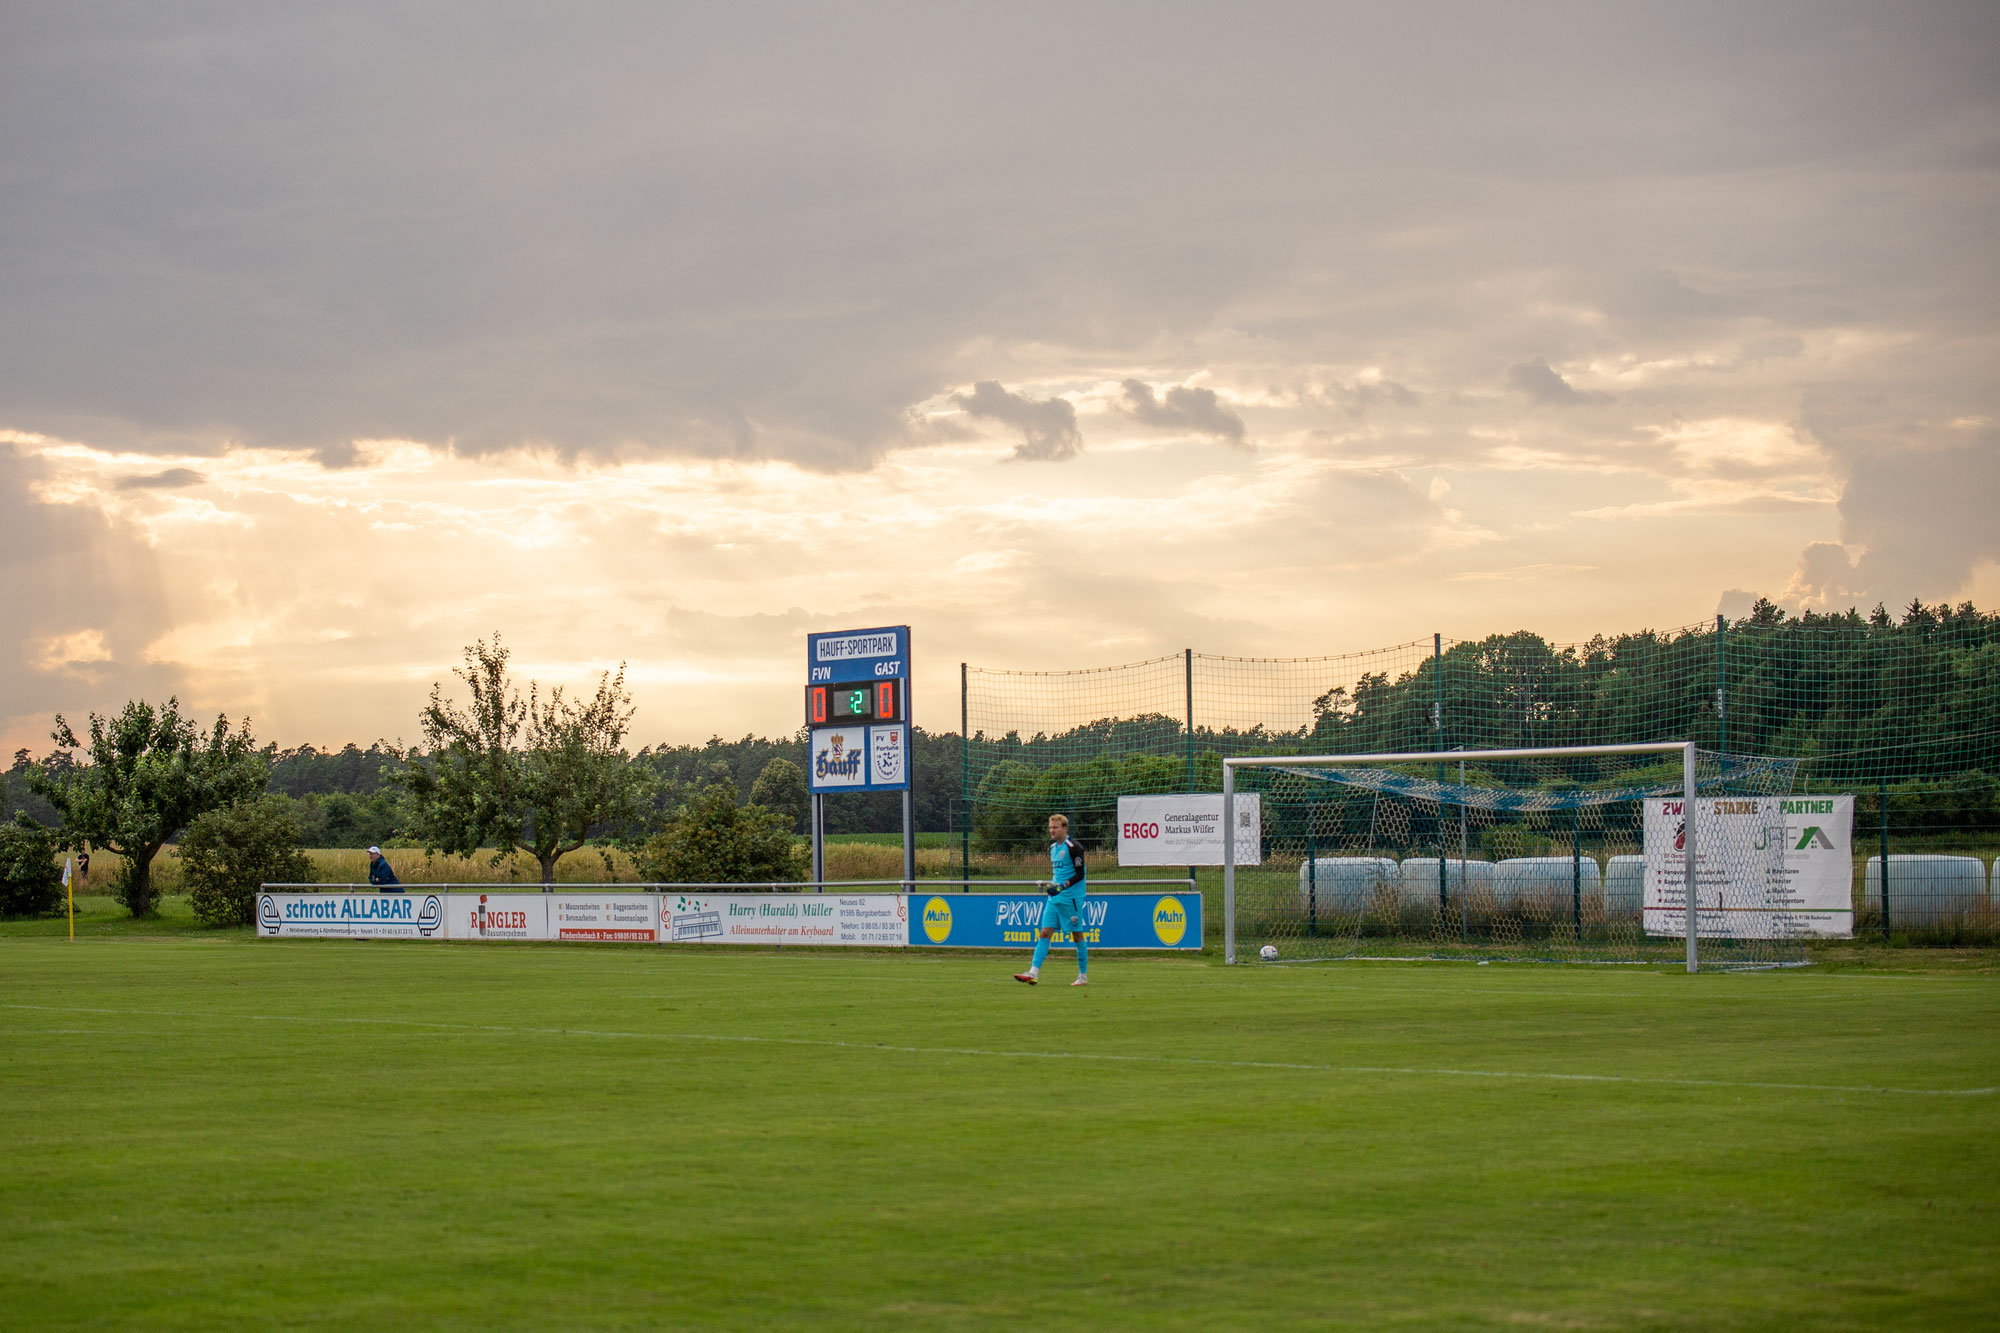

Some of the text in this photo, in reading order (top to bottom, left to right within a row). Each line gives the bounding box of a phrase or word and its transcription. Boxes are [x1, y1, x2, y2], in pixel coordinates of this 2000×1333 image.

[820, 636, 894, 657] HAUFF-SPORTPARK
[812, 661, 901, 680] FVN GAST
[816, 748, 863, 780] Hauff
[1713, 801, 1758, 815] STARKE
[1780, 800, 1833, 814] PARTNER
[1164, 813, 1219, 823] Generalagentur
[1123, 823, 1159, 839] ERGO
[1164, 825, 1215, 834] Markus Wilfer
[286, 899, 412, 919] schrott ALLABAR
[613, 903, 648, 911] Baggerarbeiten
[729, 903, 833, 919] Harry (Harald) Müller
[856, 909, 892, 918] Burgoberbach
[996, 901, 1043, 926] PKW
[925, 909, 949, 921] Muhr
[1156, 909, 1183, 922] Muhr
[729, 925, 834, 938] Alleinunterhalter am Keyboard
[841, 922, 859, 930] Telefon:
[1004, 931, 1031, 942] zum
